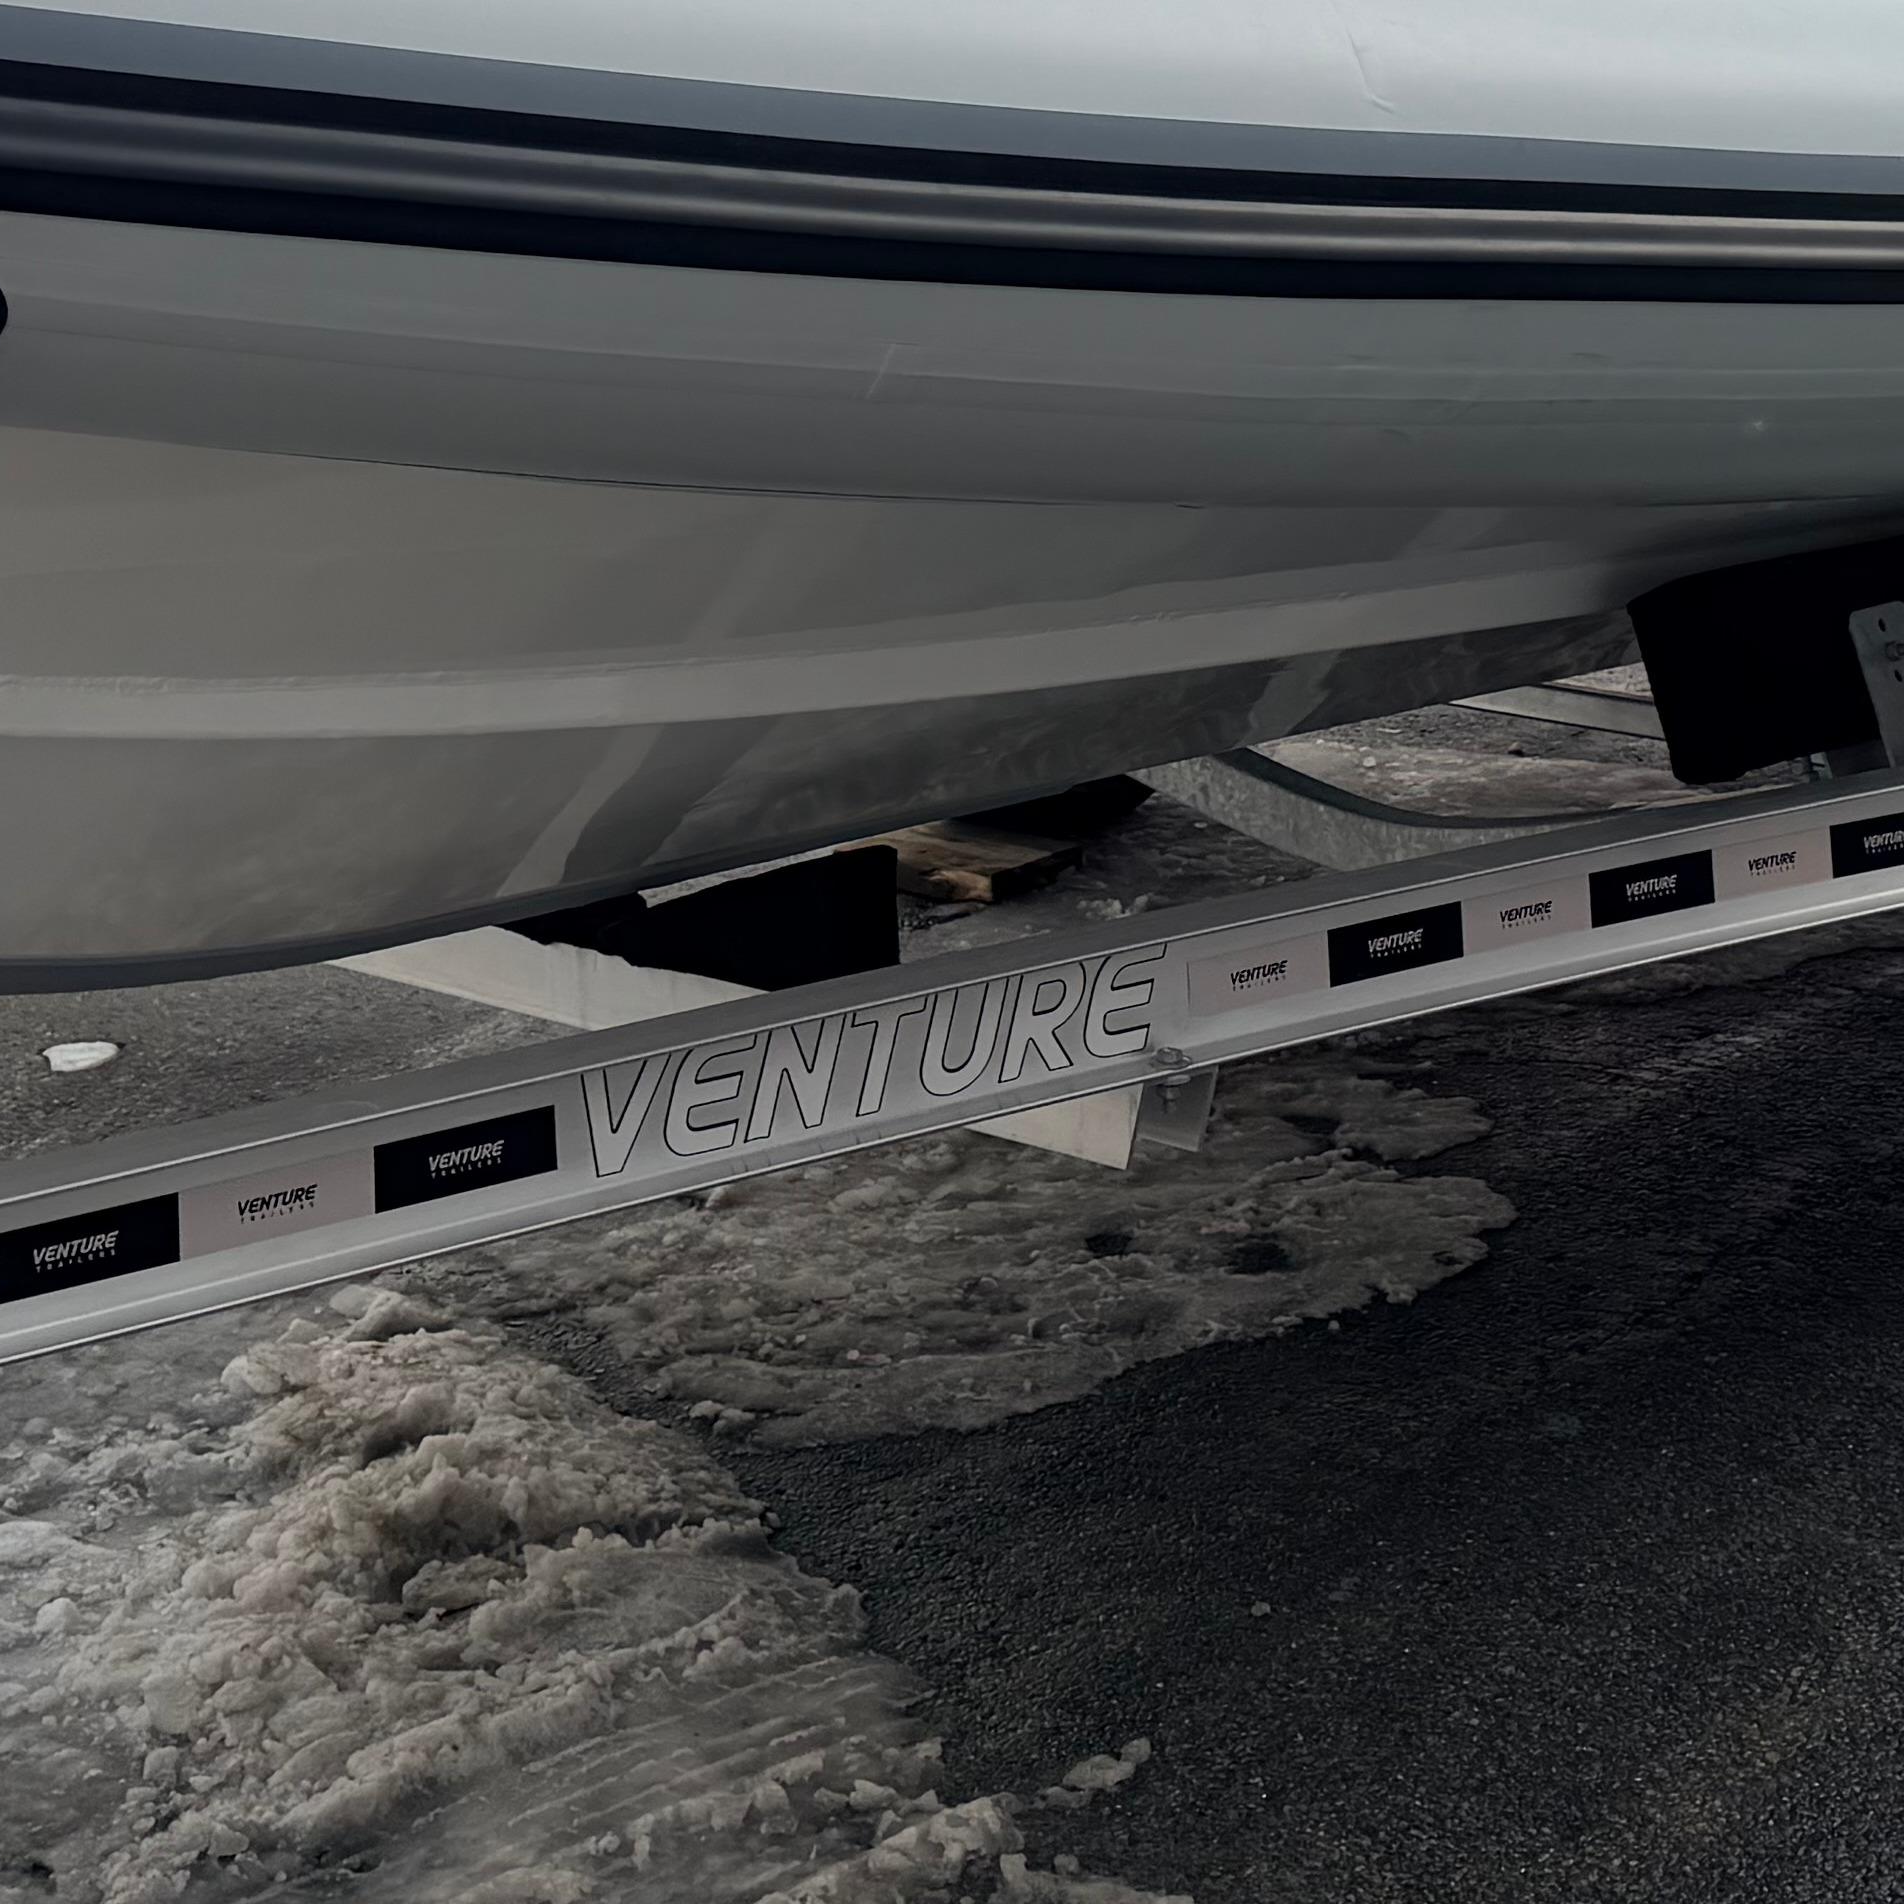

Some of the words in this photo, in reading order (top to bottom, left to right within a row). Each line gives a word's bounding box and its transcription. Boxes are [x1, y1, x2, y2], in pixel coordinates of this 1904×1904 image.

[1625, 874, 1677, 896] VENTURE
[1499, 900, 1552, 923] VENTURE
[1368, 928, 1423, 953] VENTURE
[1230, 959, 1288, 985] VENTURE
[579, 941, 1168, 1178] VENTURE
[429, 1139, 505, 1172] VENTURE
[237, 1184, 318, 1217] VENTURE
[32, 1230, 119, 1265] VENTURE
